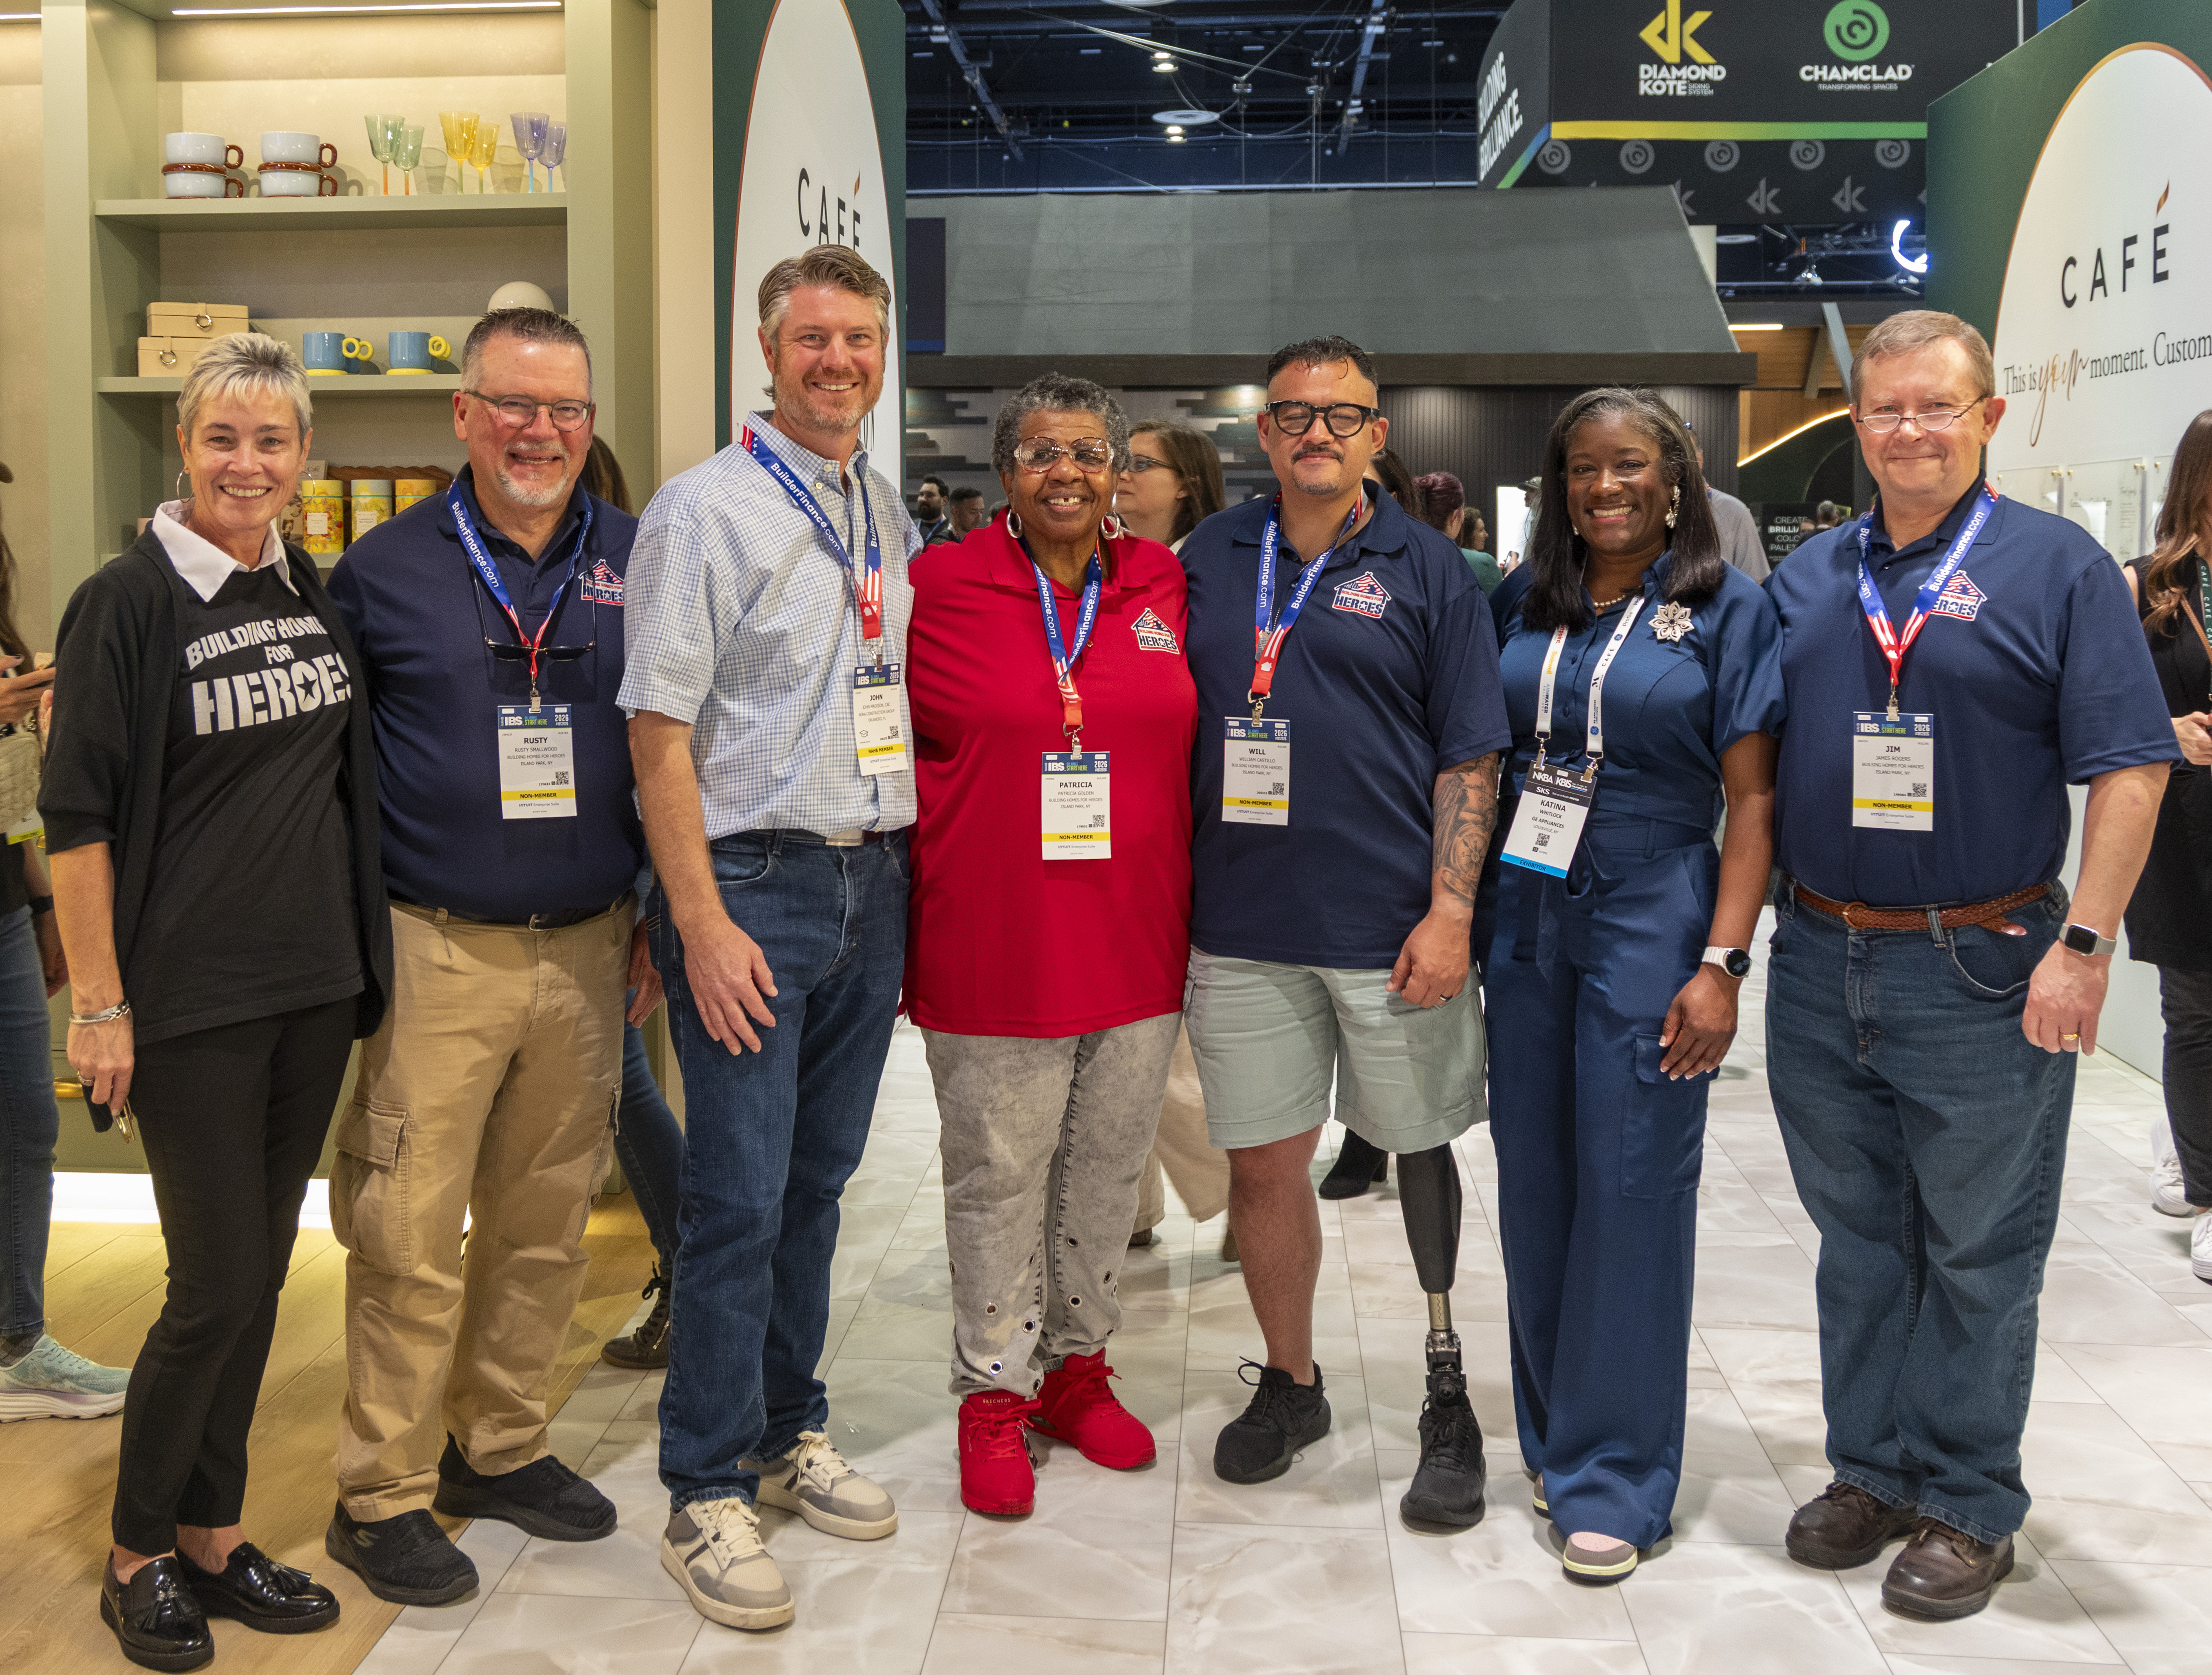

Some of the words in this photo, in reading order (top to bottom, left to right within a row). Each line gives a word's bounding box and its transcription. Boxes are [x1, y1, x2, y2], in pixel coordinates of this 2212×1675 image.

[1639, 64, 1726, 81] DIAMOND
[1799, 64, 1913, 81] CHAMCLAD
[1639, 80, 1687, 95] KOTE
[2061, 180, 2170, 308] CAFÉ
[2153, 332, 2212, 366] Custom
[2090, 347, 2148, 379] moment.
[2004, 365, 2026, 395] This
[2029, 364, 2037, 391] is
[2030, 348, 2090, 447] your
[770, 462, 840, 552] BuilderFinance.com
[452, 501, 499, 588] BuilderFinance.com
[1928, 511, 1985, 592] BuilderFinance.com
[1259, 520, 1277, 608] BuilderFinance.com
[1334, 595, 1383, 614] HEROES
[1932, 599, 1977, 615] EROES
[1069, 580, 1098, 664] BuilderFinance.com
[1622, 612, 1633, 626] Profile
[185, 619, 277, 670] BUILDING
[1138, 635, 1177, 650] HEROES
[264, 644, 295, 665] FOR
[1546, 651, 1557, 674] Bodewell
[858, 675, 870, 685] IBS
[504, 716, 522, 726] IBS
[1860, 723, 1880, 733] IBS
[1230, 728, 1246, 737] IBS
[1048, 762, 1065, 771] IBS
[1532, 771, 1553, 784] NKBA
[1555, 776, 1572, 788] KBIS
[1536, 787, 1550, 795] SKS
[1540, 809, 1562, 819] WHITLOCK
[1541, 799, 1566, 812] KATINA
[1533, 824, 1553, 833] LOUISVILLE,
[1538, 818, 1564, 829] APPLIANCES
[1519, 860, 1547, 871] EXHIBITOR
